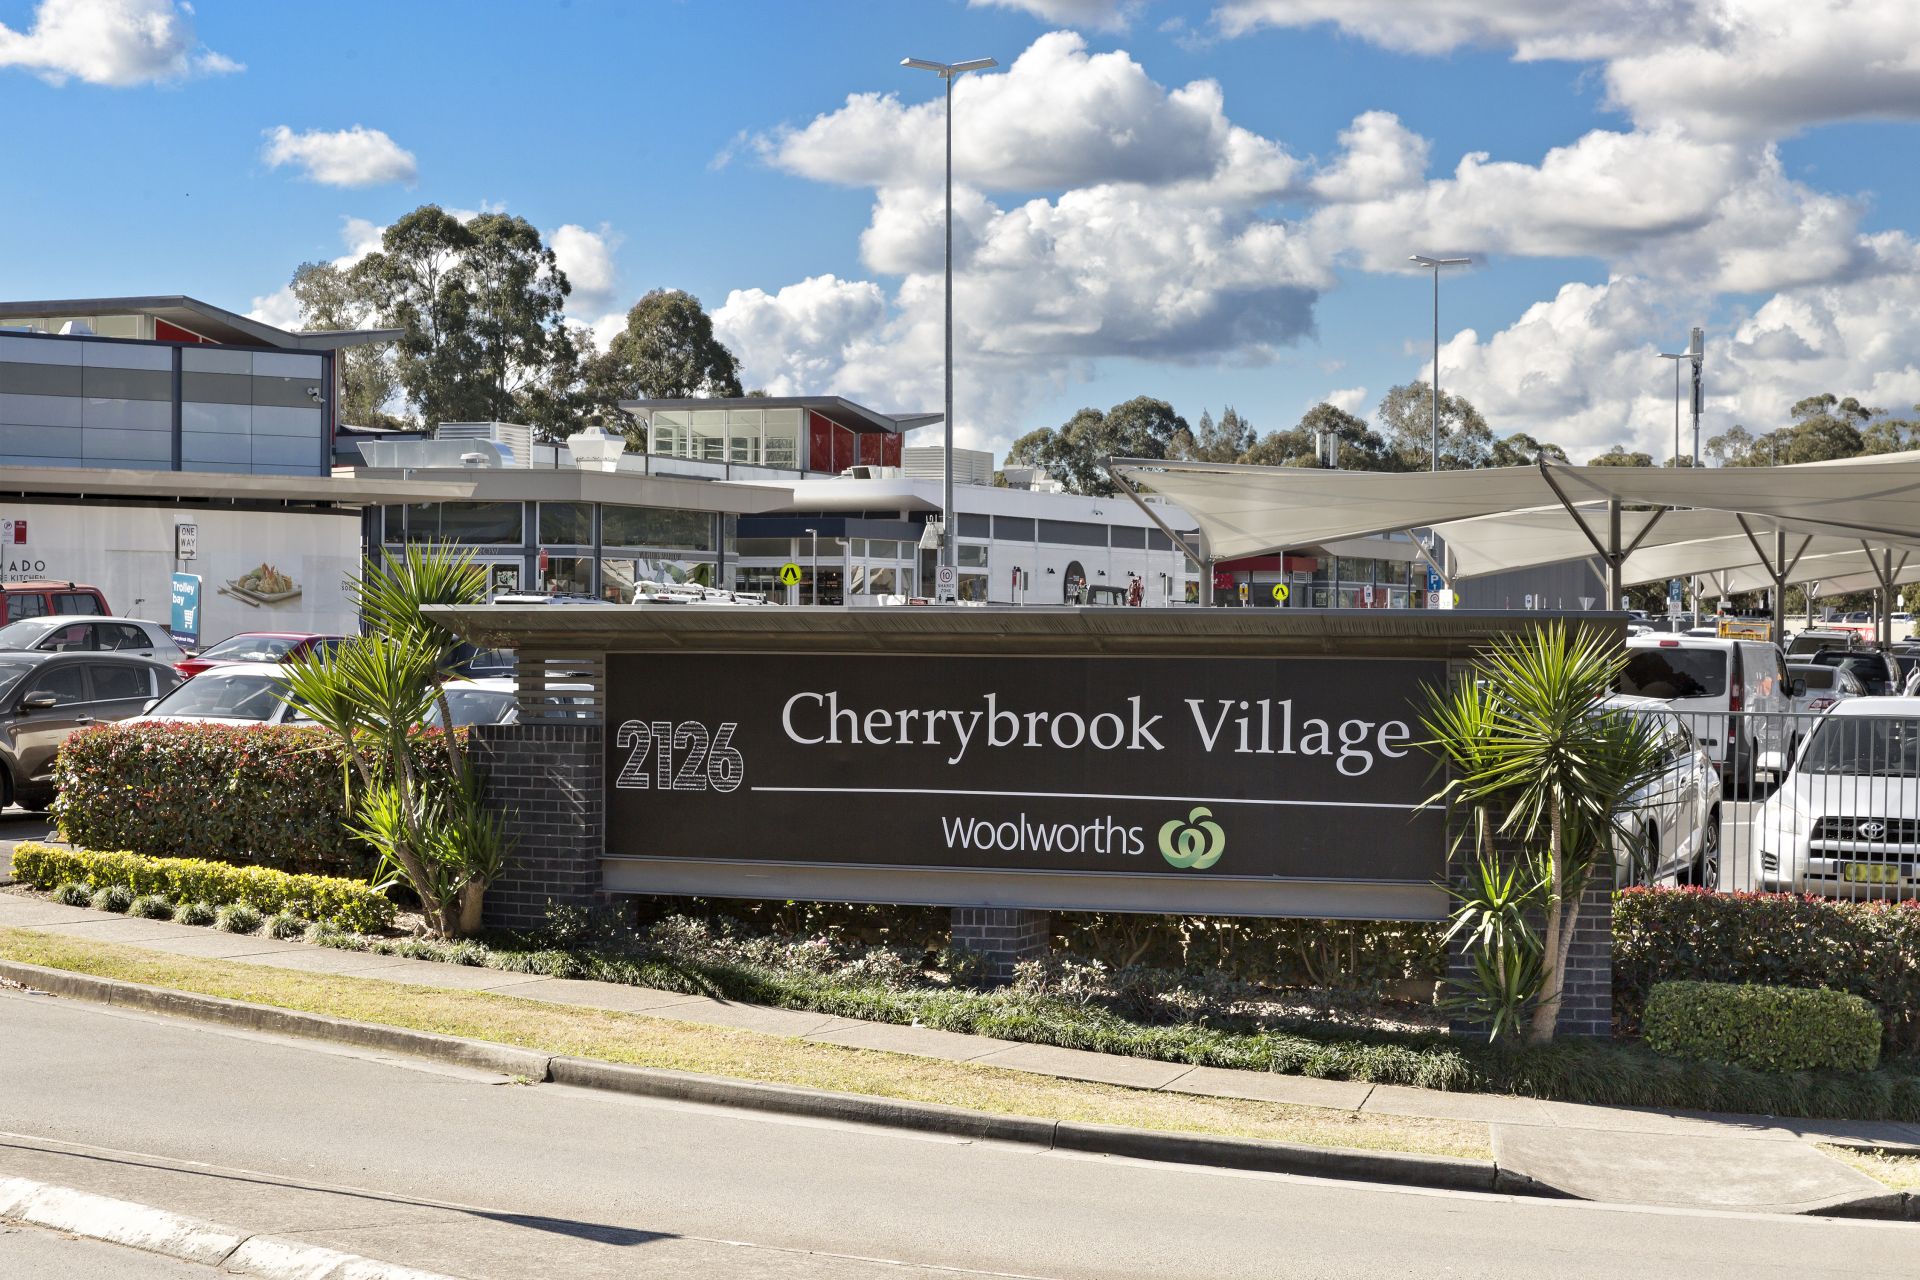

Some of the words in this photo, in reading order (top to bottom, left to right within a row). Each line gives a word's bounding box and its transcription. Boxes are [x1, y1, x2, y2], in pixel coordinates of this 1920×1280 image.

[181, 527, 195, 536] ONE
[181, 538, 196, 547] WAY
[0, 560, 46, 572] ADO
[172, 580, 195, 596] Trolley
[172, 592, 185, 607] bay
[782, 691, 1165, 765] Cherrybrook
[1184, 698, 1411, 777] Village
[616, 719, 744, 792] 2126
[941, 812, 1145, 855] Woolworths
